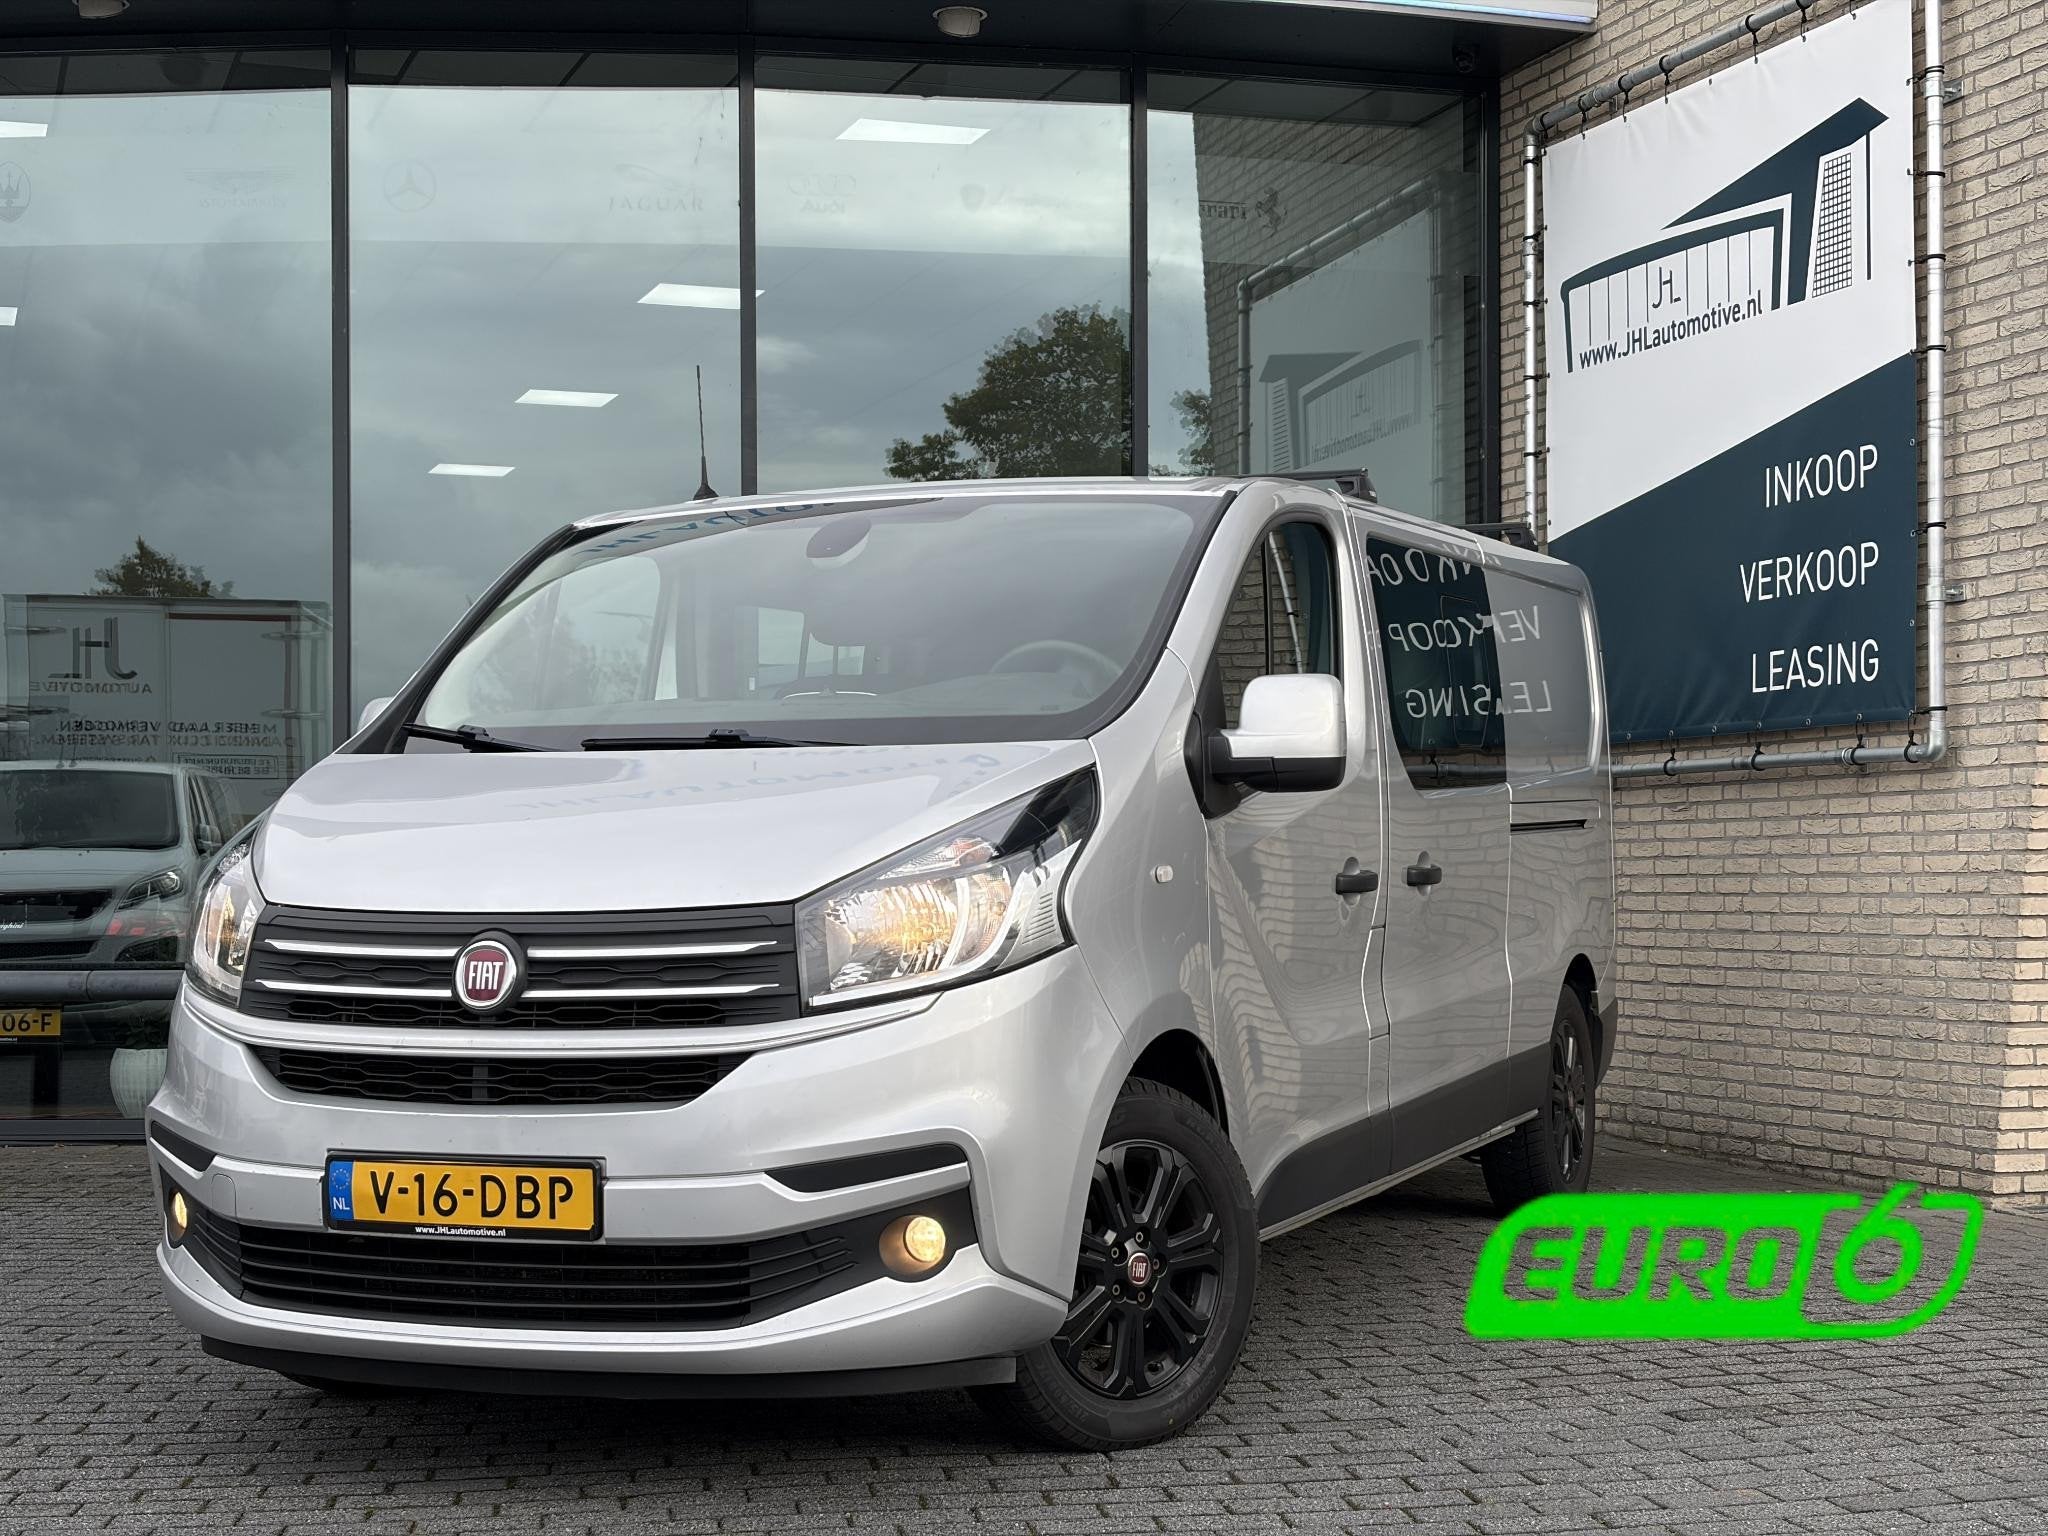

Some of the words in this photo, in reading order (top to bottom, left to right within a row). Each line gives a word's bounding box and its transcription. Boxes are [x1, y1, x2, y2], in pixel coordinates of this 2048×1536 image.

[1579, 290, 1763, 370] www.JHLautomotive.nl
[1765, 444, 1878, 508] INKOOP
[1739, 541, 1879, 603] VERKOOP
[1751, 638, 1879, 693] LEASING
[467, 961, 504, 990] FIAT
[332, 1196, 350, 1211] NL
[369, 1169, 574, 1221] V-16-DBP
[414, 1224, 507, 1238] www.JHLautomotive.nl
[1132, 1261, 1147, 1279] FIAT
